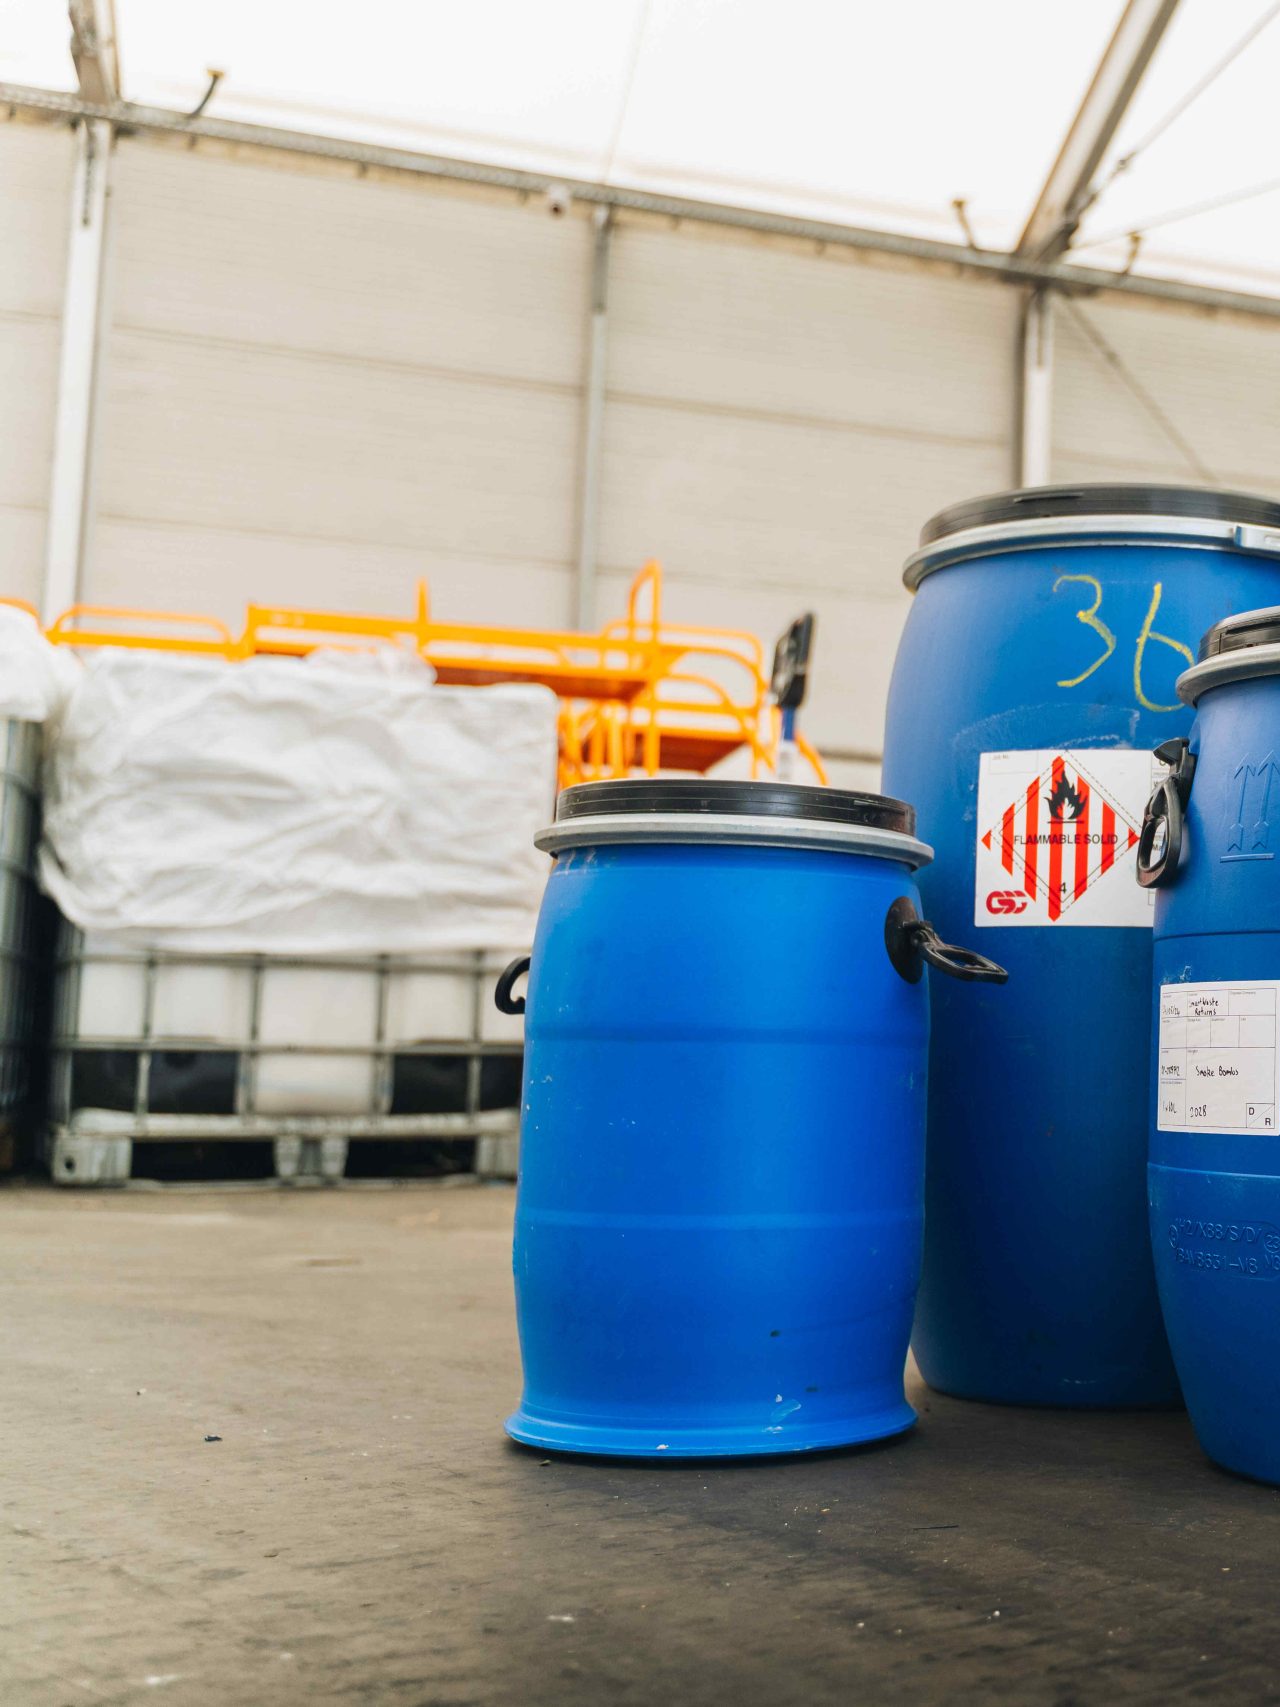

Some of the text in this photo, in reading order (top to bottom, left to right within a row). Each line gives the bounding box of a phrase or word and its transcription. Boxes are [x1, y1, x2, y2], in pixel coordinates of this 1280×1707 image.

[1053, 574, 1195, 712] 36
[1014, 834, 1118, 845] FLAMMABLE SOLID
[1059, 882, 1067, 894] 4
[1248, 1107, 1255, 1116] D
[1265, 1117, 1272, 1126] R
